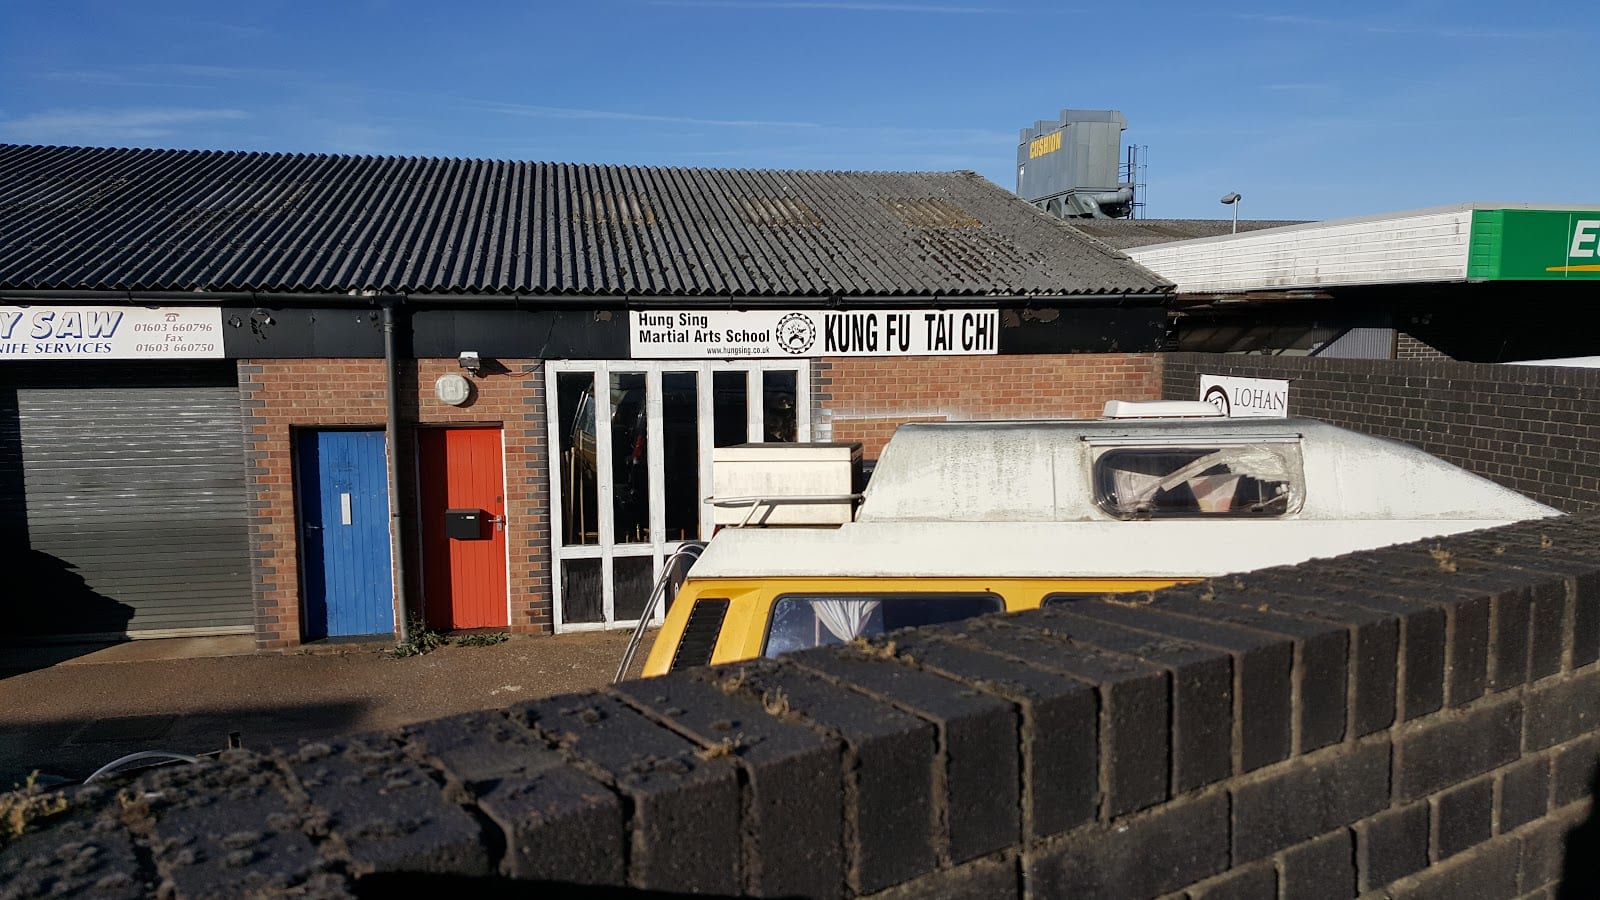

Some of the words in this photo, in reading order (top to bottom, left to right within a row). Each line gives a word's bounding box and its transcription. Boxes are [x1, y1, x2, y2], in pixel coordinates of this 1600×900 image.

[1029, 130, 1062, 160] CUSHION
[1569, 219, 1600, 257] E
[31, 311, 123, 339] SAW
[134, 324, 168, 332] 01603
[172, 324, 213, 332] 660796
[638, 313, 674, 329] Hung
[679, 313, 708, 328] Sing
[165, 334, 183, 342] Fax
[639, 330, 689, 343] Martial
[694, 330, 721, 343] Arts
[726, 329, 770, 343] School
[824, 314, 878, 352] KUNG
[886, 314, 911, 351] FU
[924, 314, 953, 351] TAI
[962, 313, 995, 351] CHI
[34, 343, 112, 354] SERVICES
[136, 344, 169, 352] 01603
[173, 344, 214, 352] 660750
[706, 346, 770, 355] www.hungsing.co.uk
[1234, 387, 1286, 411] LOHAN
